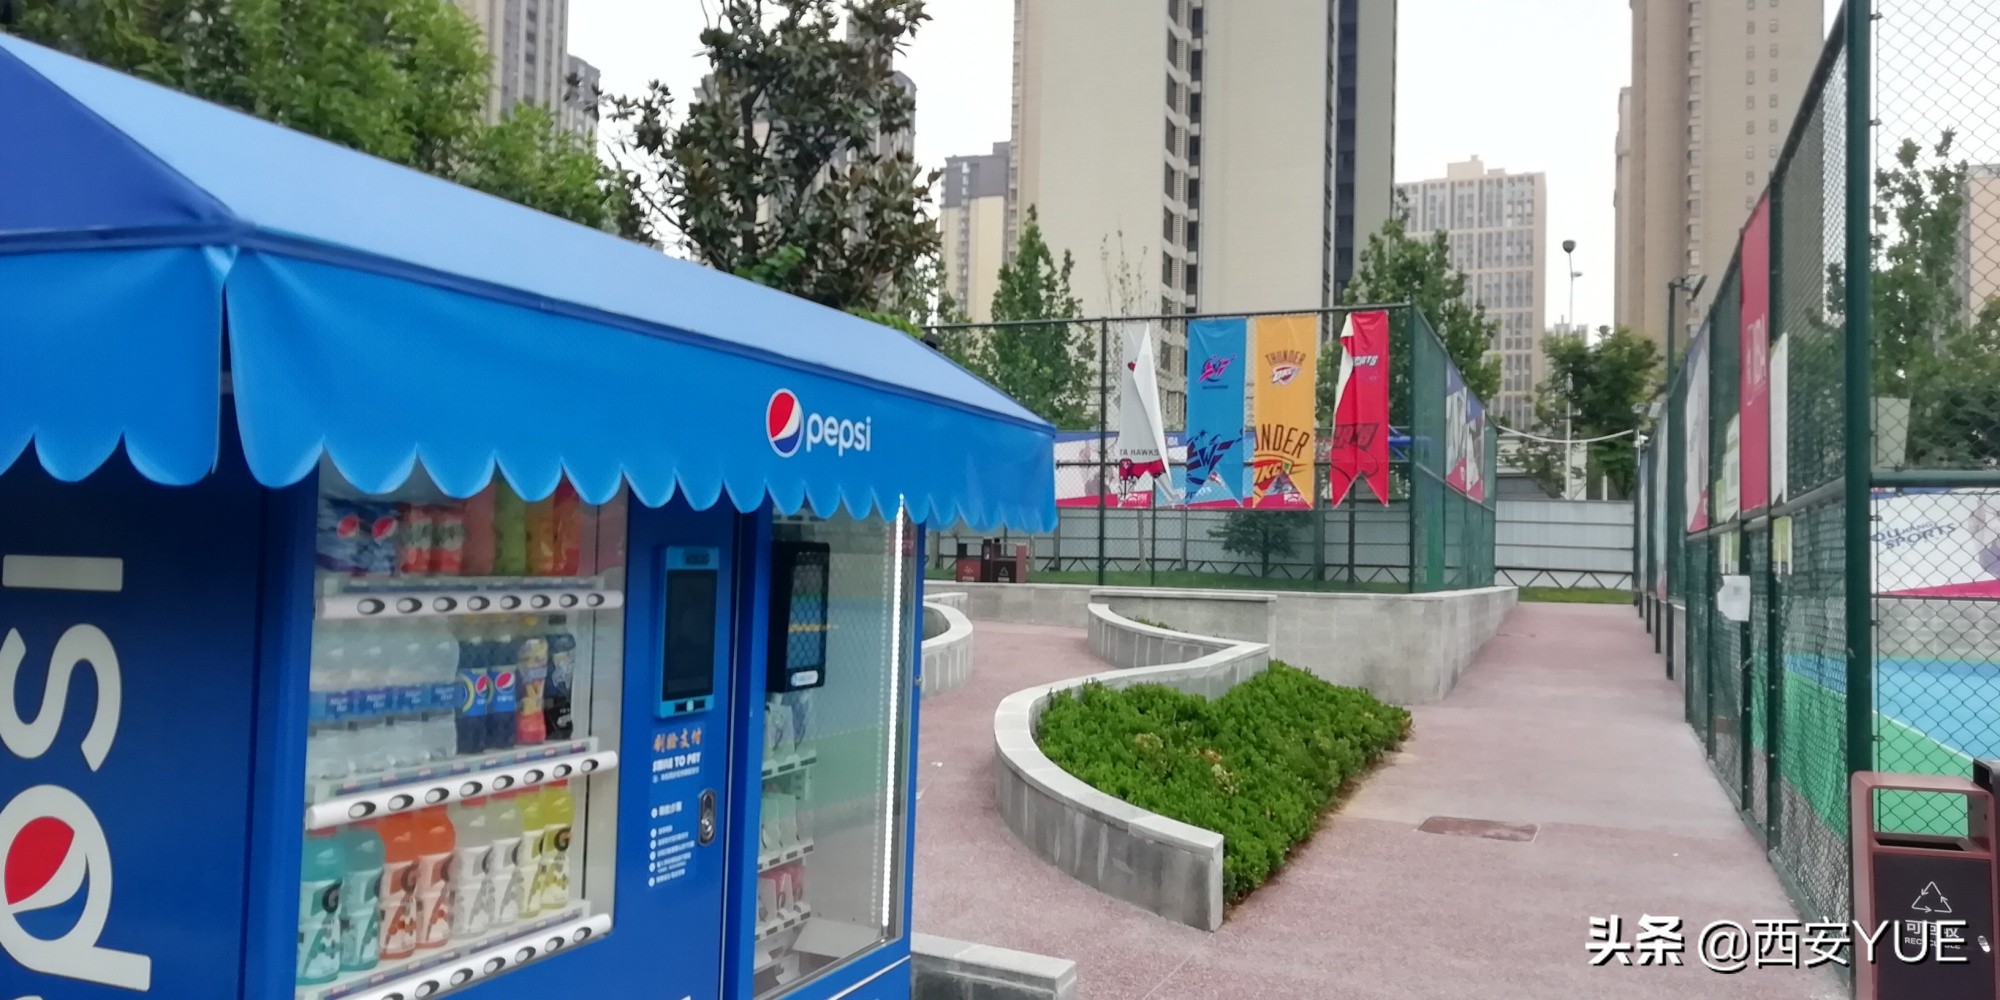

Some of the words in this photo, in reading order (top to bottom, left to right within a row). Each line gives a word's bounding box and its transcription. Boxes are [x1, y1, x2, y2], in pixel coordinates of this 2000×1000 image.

[1265, 350, 1306, 366] THUNDER
[806, 413, 871, 457] pepsi
[674, 754, 686, 768] TO
[0, 554, 152, 1000] psi
